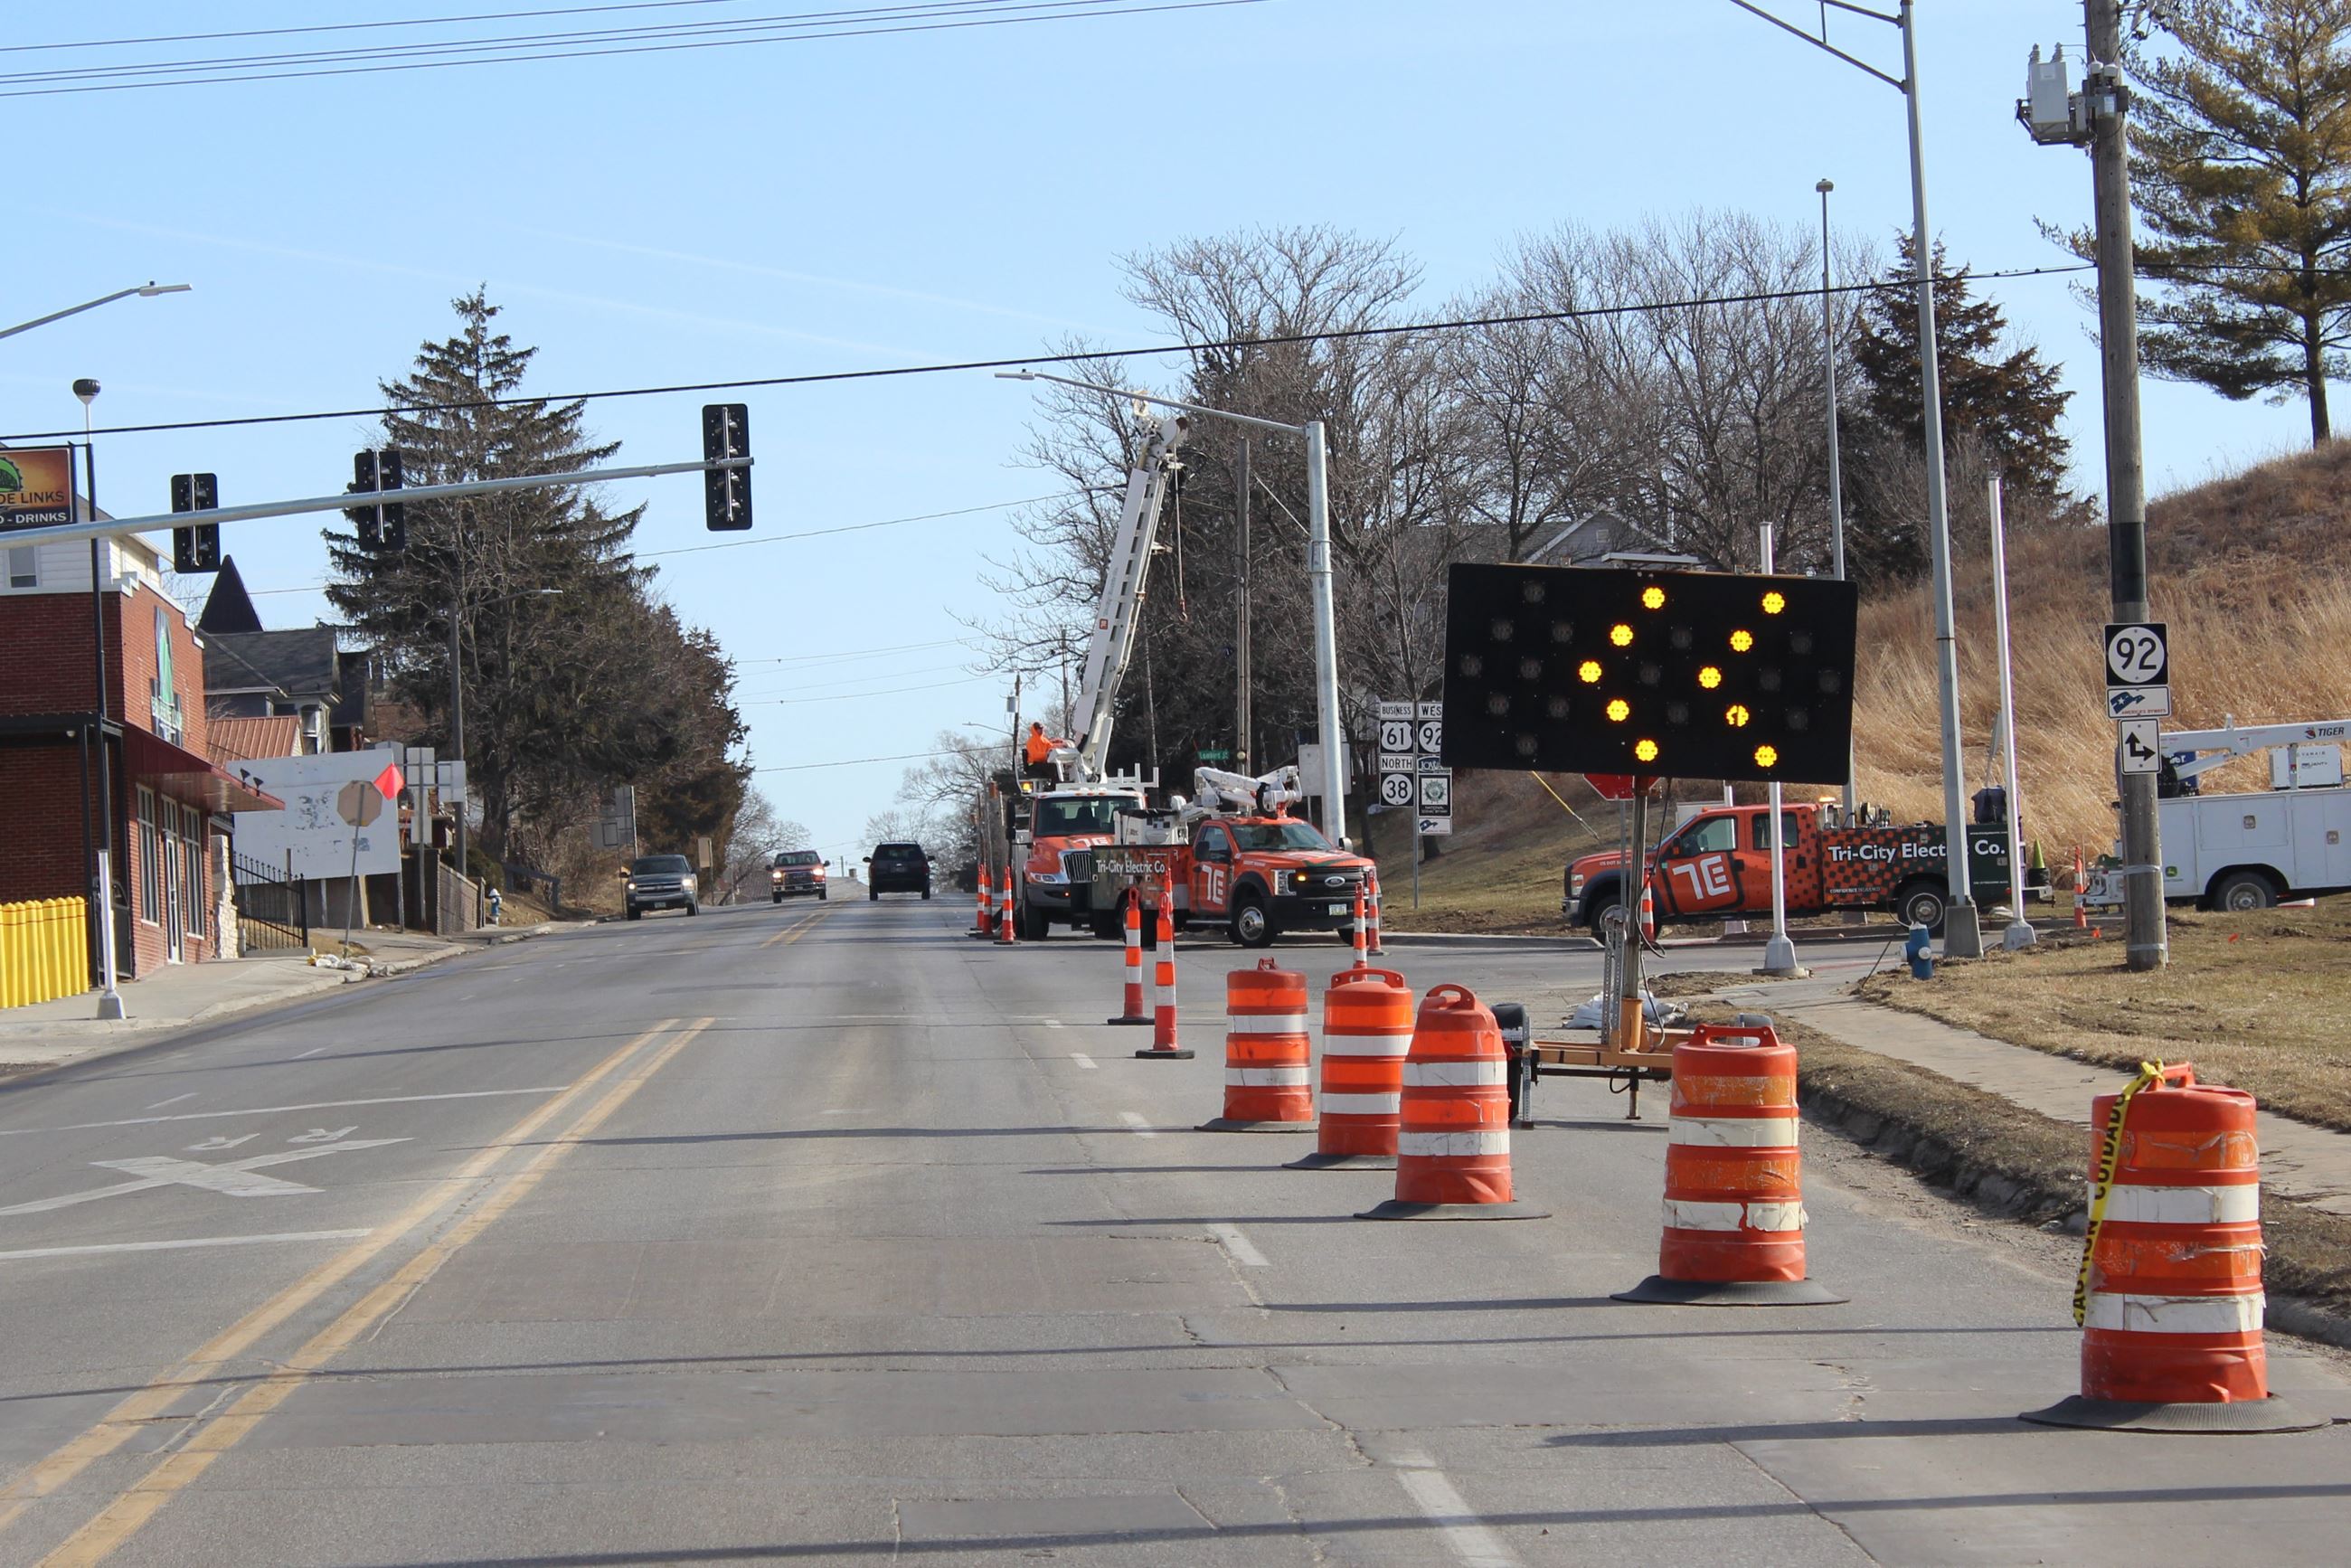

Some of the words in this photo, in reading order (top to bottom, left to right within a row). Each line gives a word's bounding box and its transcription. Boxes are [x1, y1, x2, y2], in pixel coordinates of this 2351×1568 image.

[21, 491, 65, 504] LINKS
[15, 512, 67, 524] DRINKS
[2116, 637, 2157, 670] 92
[1382, 706, 1412, 715] BUSINESS
[1421, 705, 1442, 716] WES
[1386, 727, 1405, 746] 61
[2318, 726, 2345, 737] TIGER
[1382, 758, 1412, 769] NORTH
[1385, 779, 1408, 799] 38
[1827, 844, 1896, 864] Tri-City
[1974, 839, 2006, 855] Co.
[1095, 860, 1123, 876] Tri-City
[1125, 859, 1153, 874] Electric
